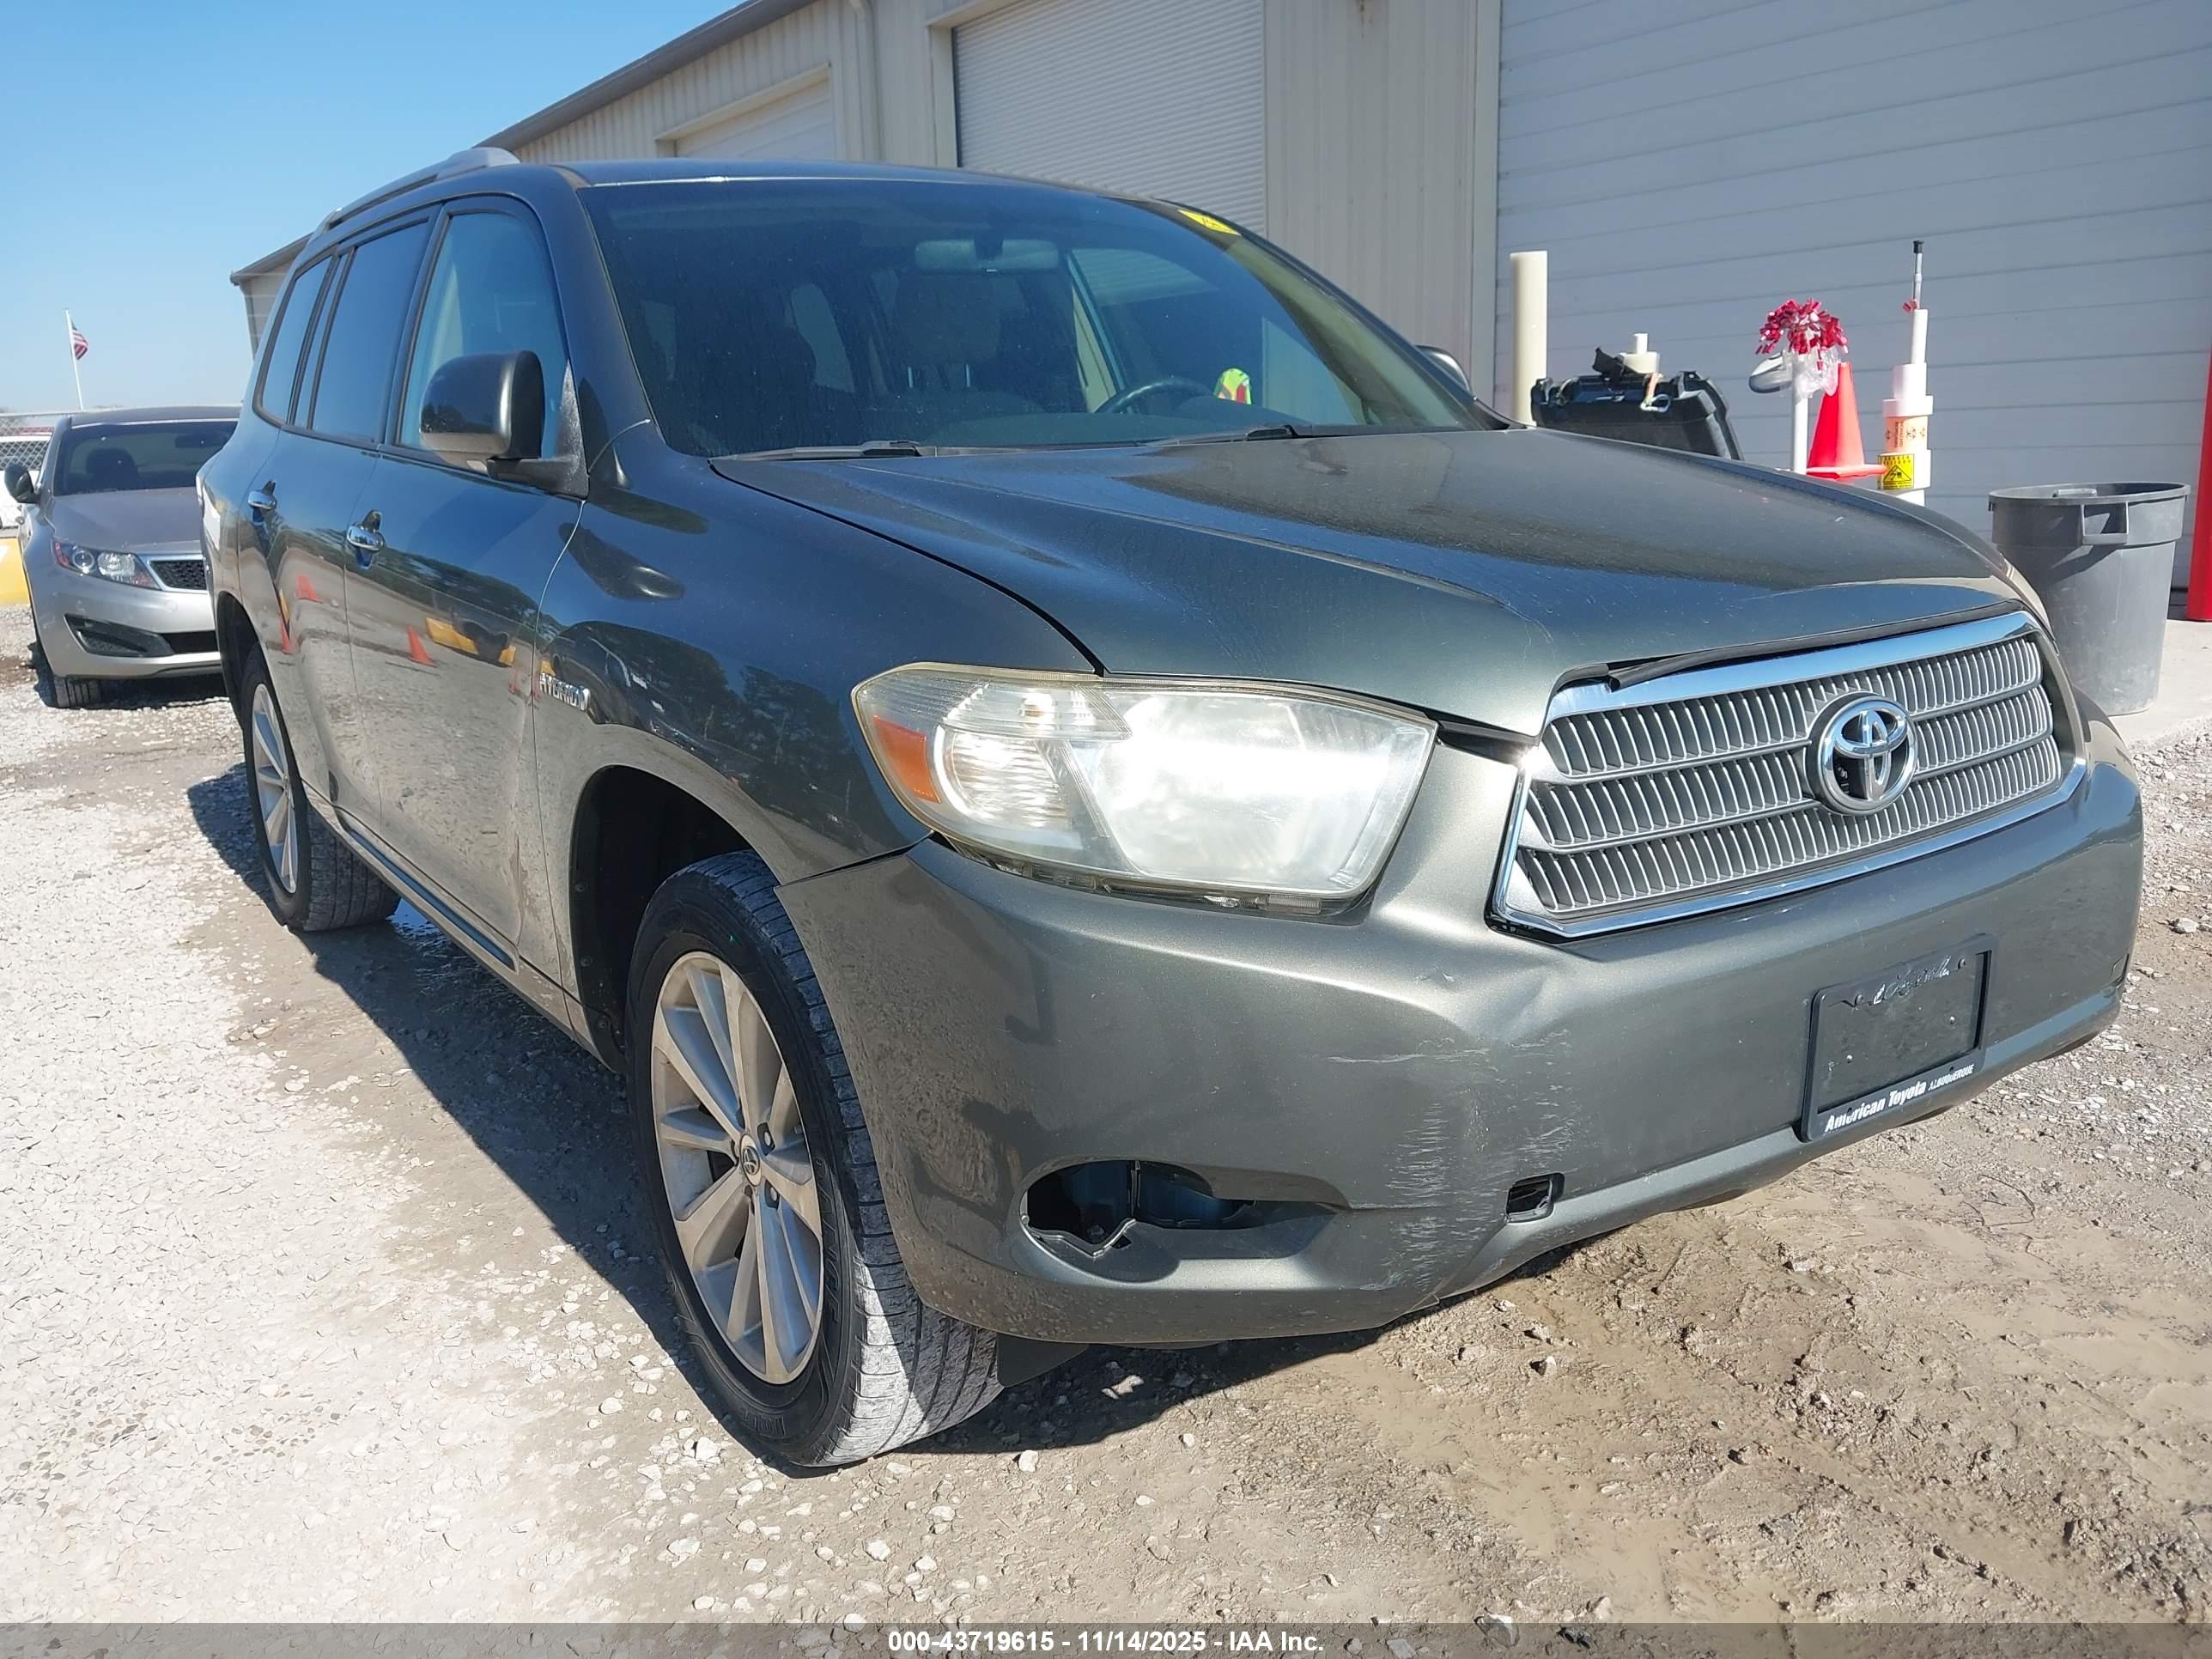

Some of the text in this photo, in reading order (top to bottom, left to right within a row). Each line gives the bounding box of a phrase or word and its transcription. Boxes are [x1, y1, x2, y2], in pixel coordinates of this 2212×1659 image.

[539, 672, 579, 708] HYBRID
[1824, 1097, 1886, 1133] American
[1887, 1080, 1927, 1107] Toyota
